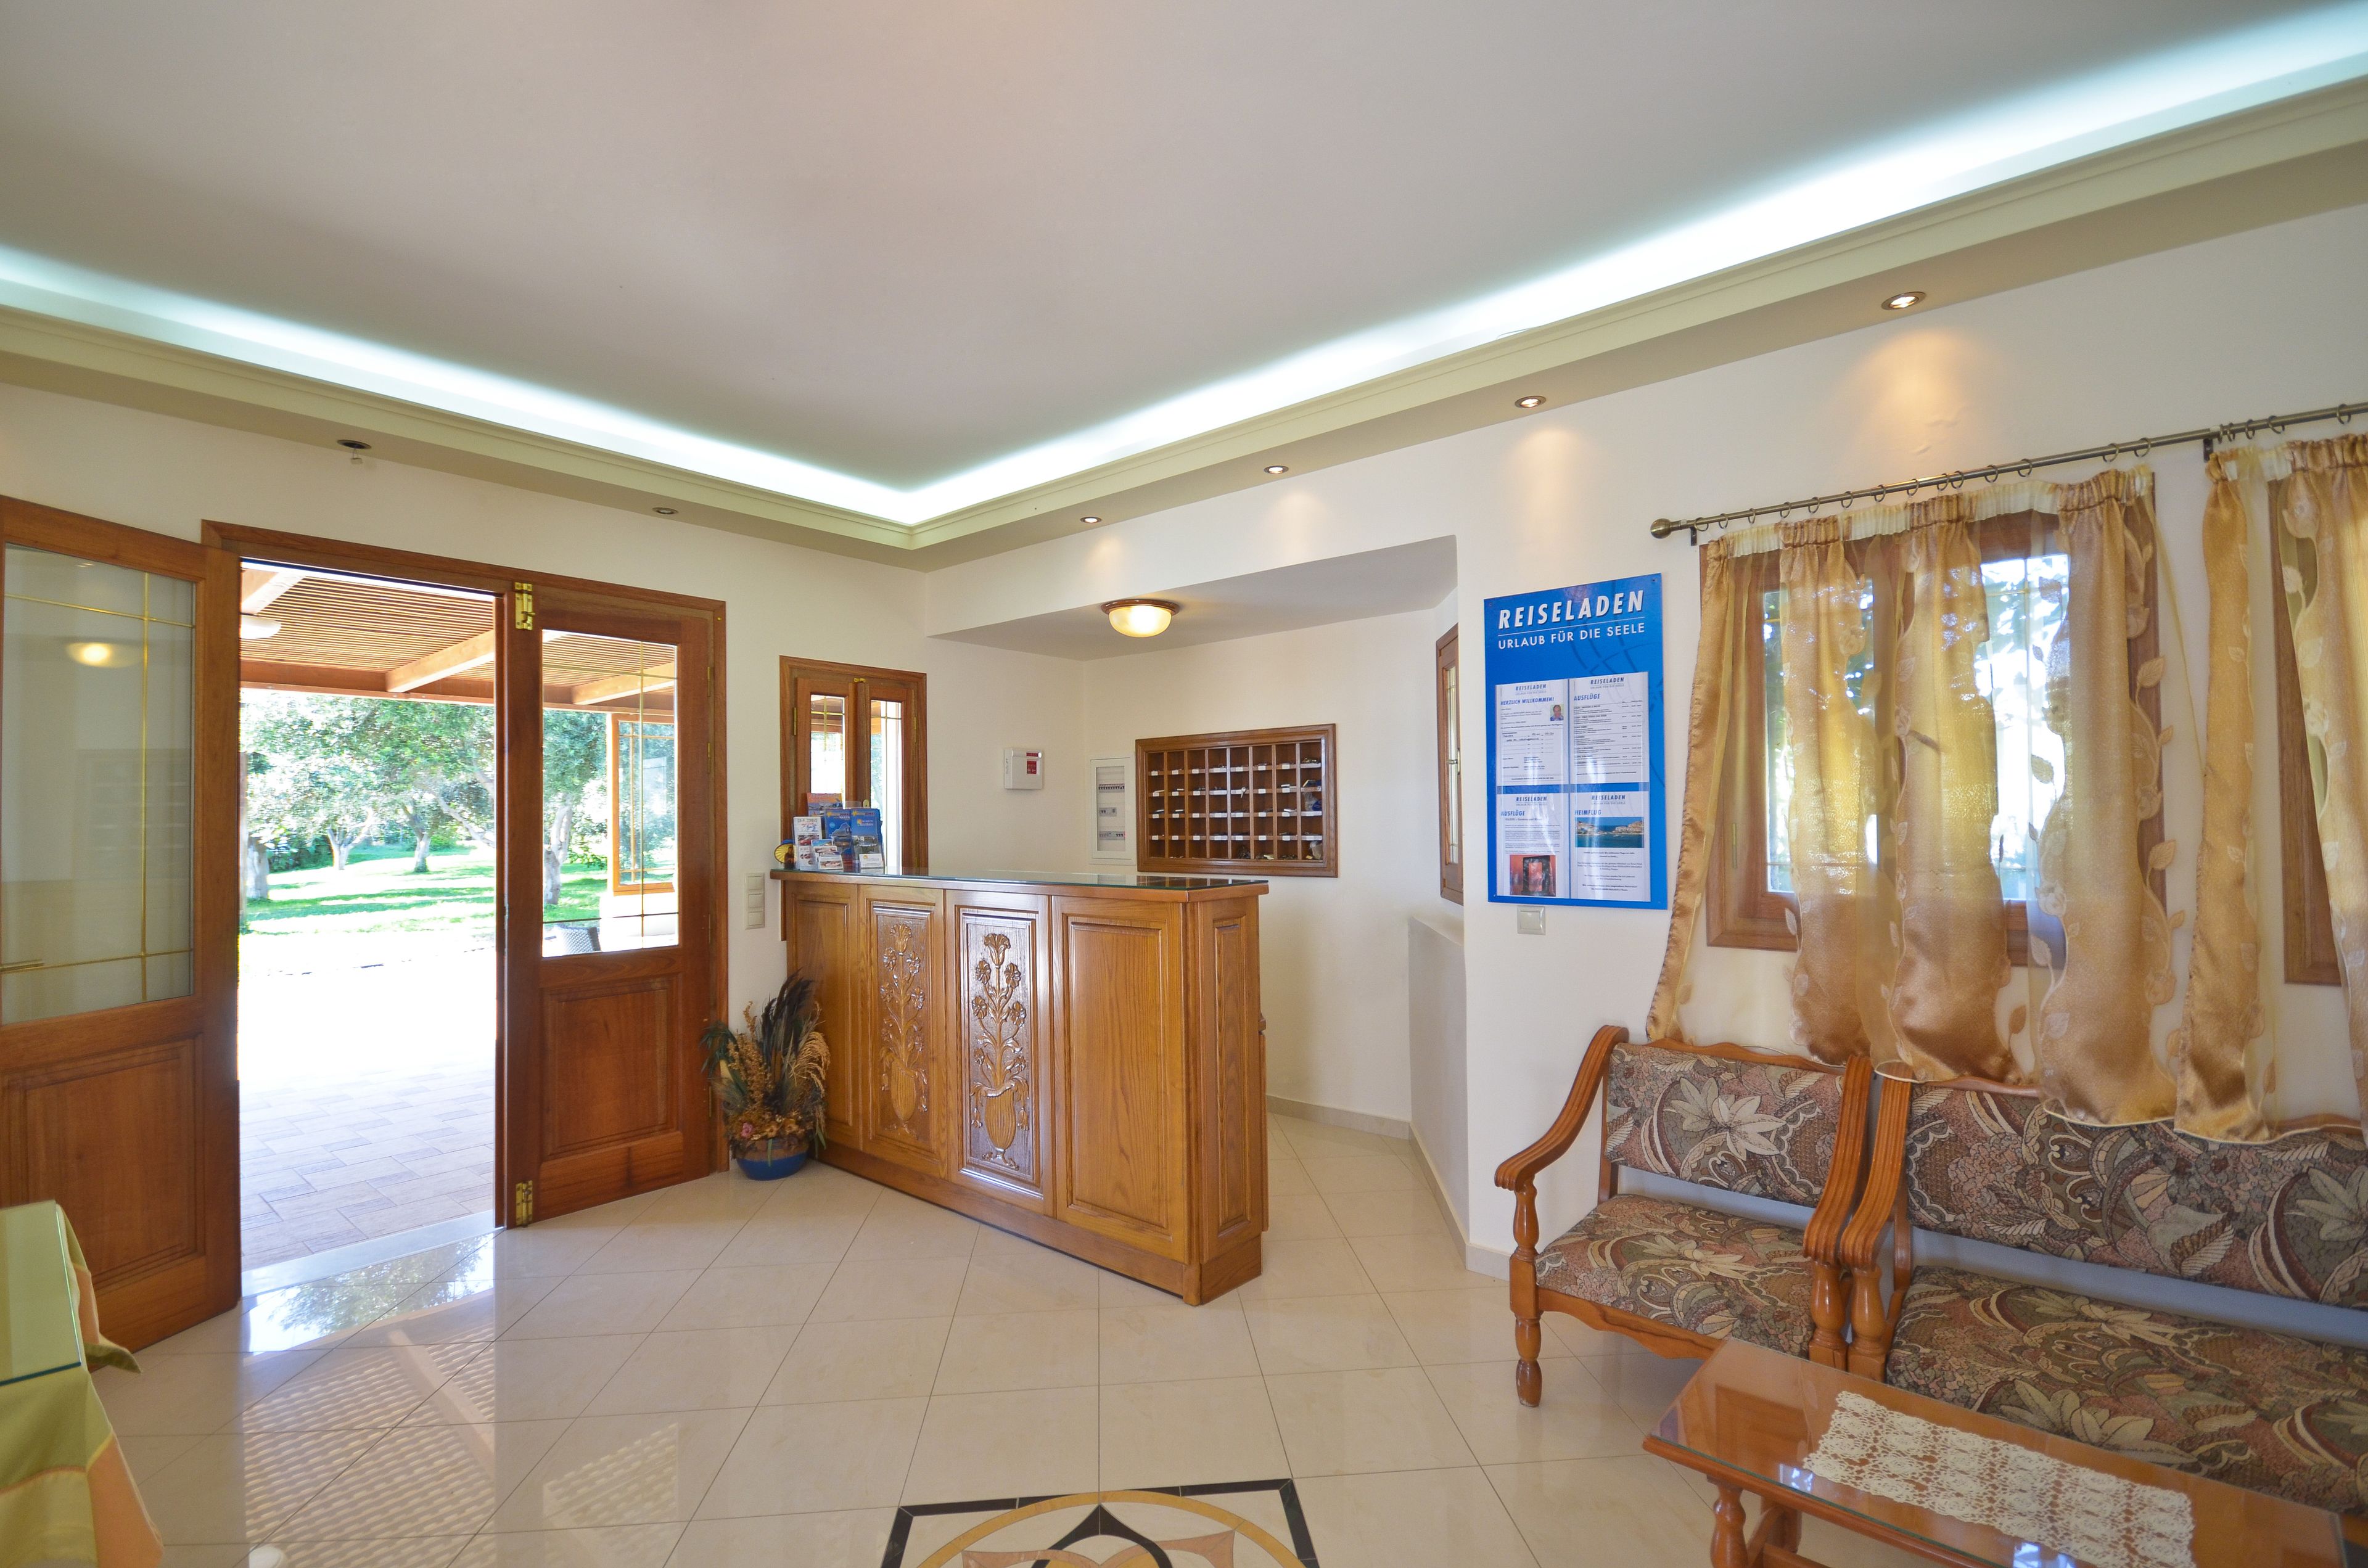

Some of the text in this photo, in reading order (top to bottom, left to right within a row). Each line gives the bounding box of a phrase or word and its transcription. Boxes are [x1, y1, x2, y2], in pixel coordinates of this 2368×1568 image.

[1498, 590, 1644, 630] REISELADEN
[1498, 622, 1645, 650] URLAUB FÜR DIE SEELE
[1590, 677, 1624, 685] REISELADEN
[1574, 693, 1601, 701] AUSFLÜGE
